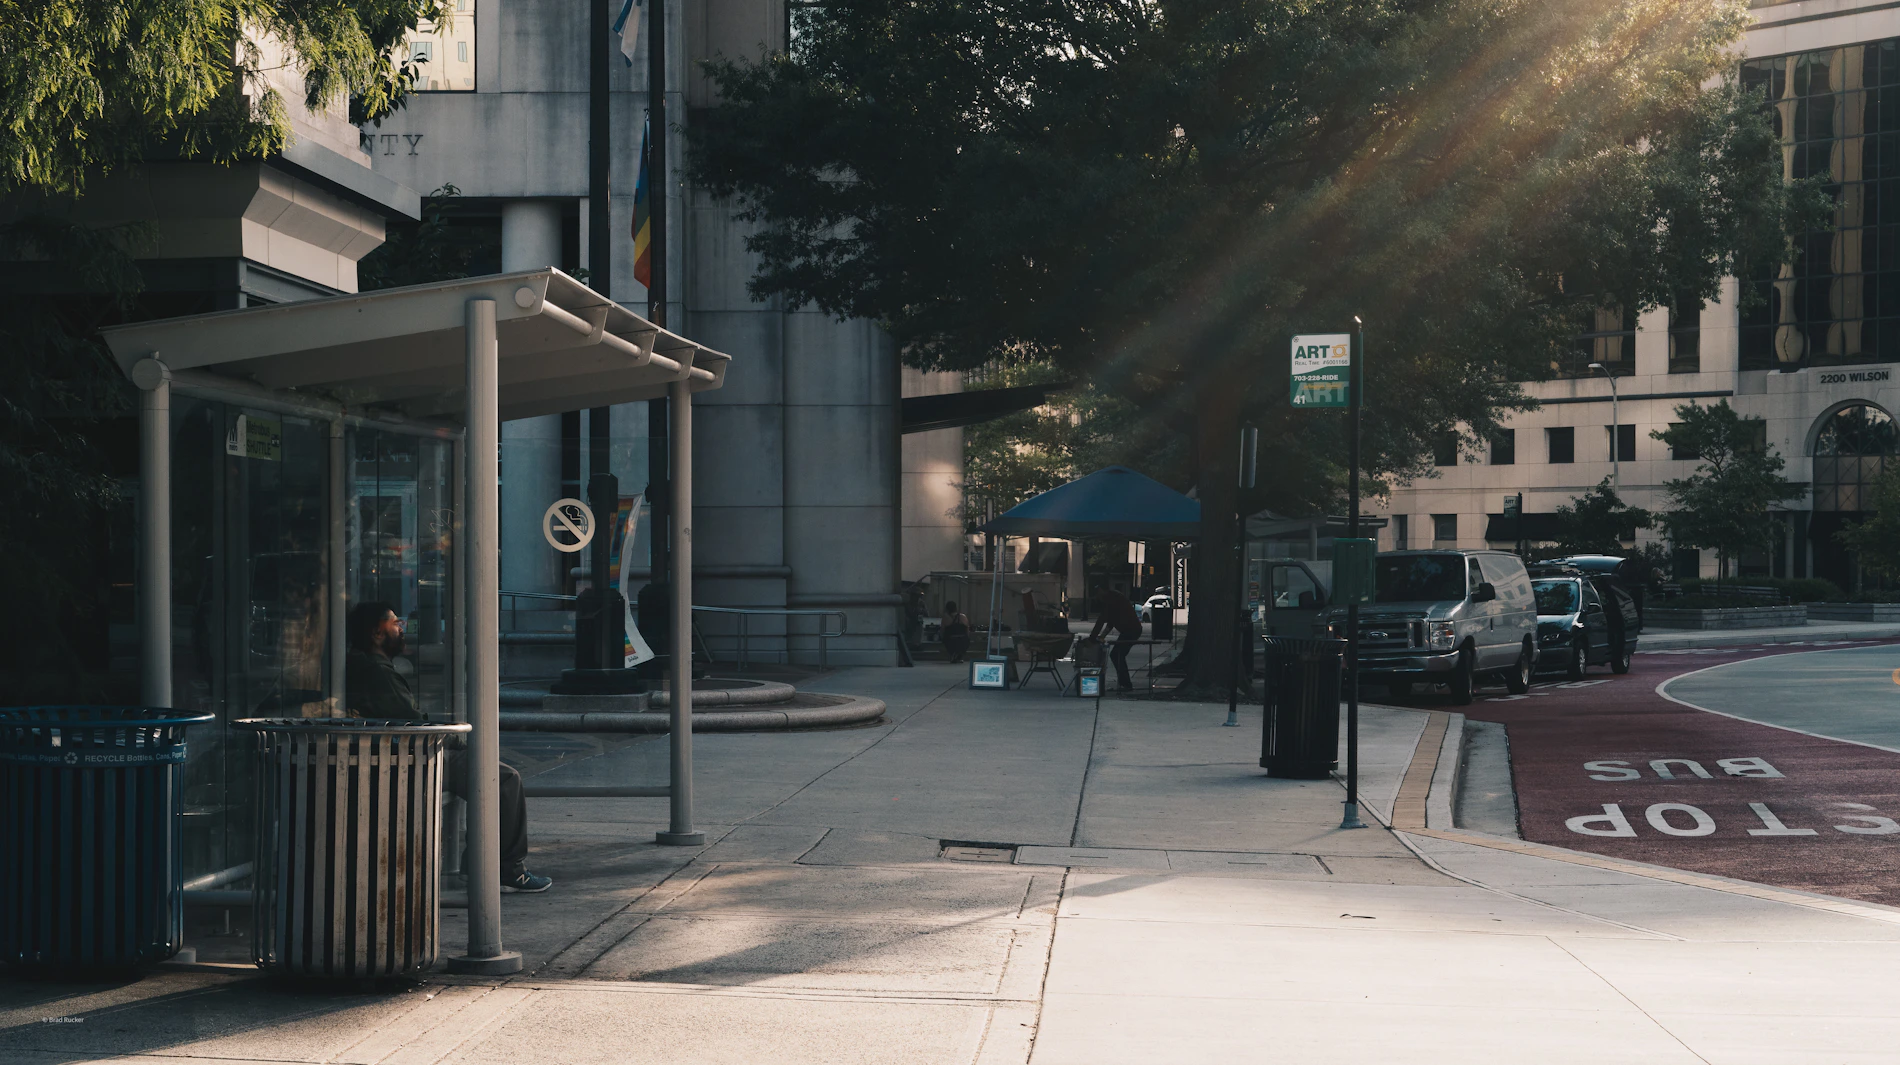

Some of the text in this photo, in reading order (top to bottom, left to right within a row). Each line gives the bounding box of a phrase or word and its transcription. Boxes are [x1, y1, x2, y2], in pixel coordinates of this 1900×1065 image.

[1295, 345, 1330, 359] ART
[1294, 374, 1339, 382] 703-228-RIDE
[1820, 371, 1889, 384] 2200 WILSON
[1293, 395, 1306, 404] 41
[1583, 757, 1786, 781] BUS
[1564, 803, 1900, 838] STOP
